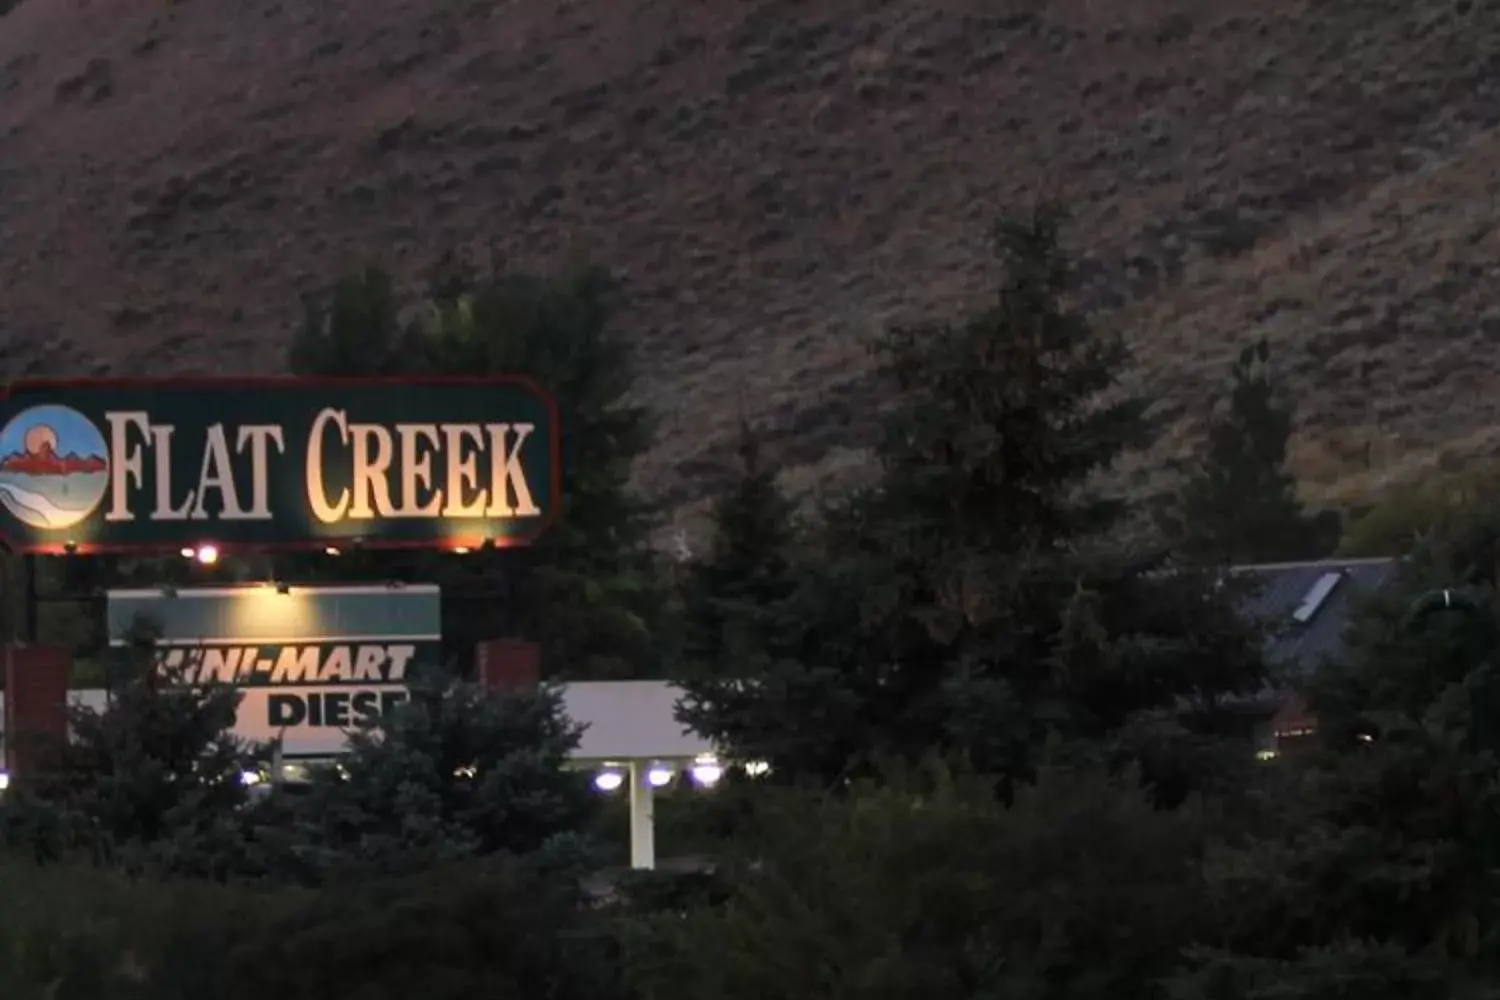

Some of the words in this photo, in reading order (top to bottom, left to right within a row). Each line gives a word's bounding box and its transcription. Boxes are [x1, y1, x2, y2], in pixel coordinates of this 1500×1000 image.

[105, 411, 285, 521] FLAT
[306, 407, 541, 524] CREEK
[268, 691, 411, 727] DIES
